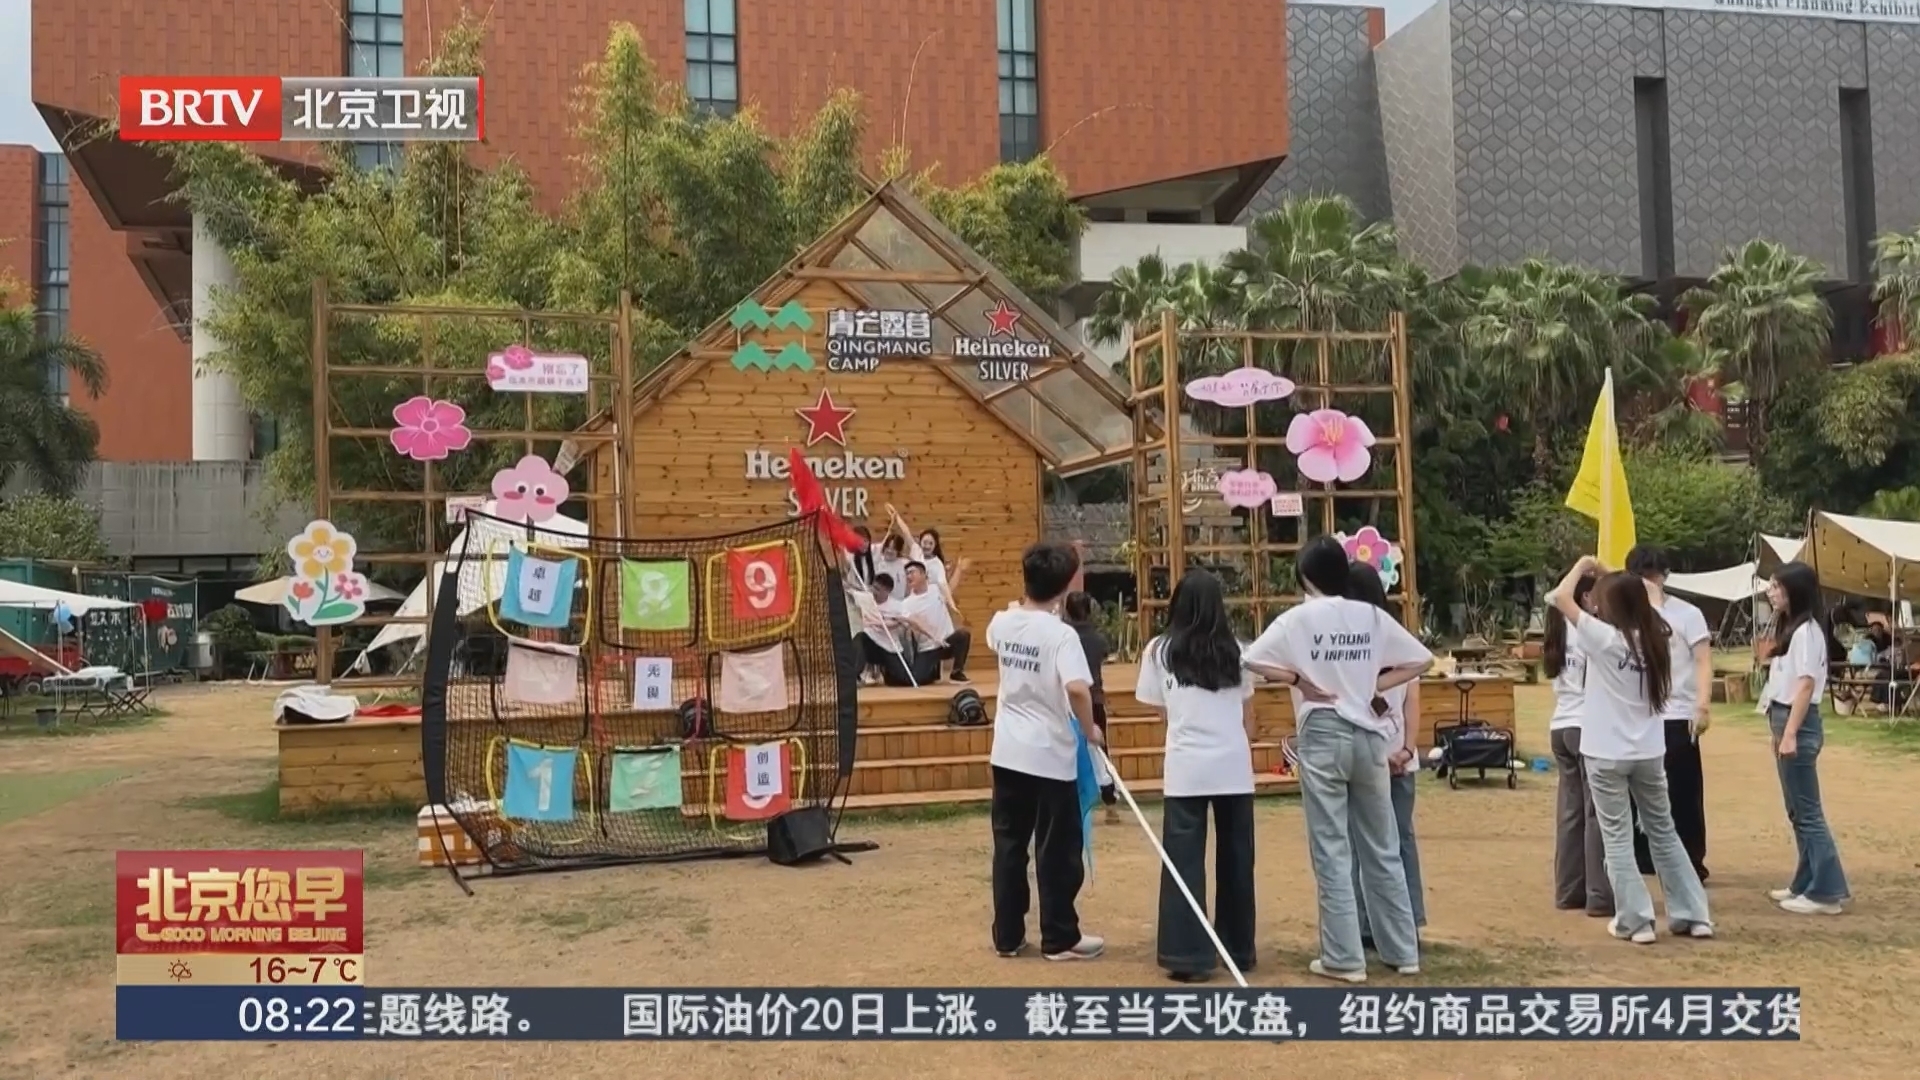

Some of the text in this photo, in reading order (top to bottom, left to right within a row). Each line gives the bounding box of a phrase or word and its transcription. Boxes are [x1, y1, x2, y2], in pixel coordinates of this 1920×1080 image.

[827, 339, 932, 355] QINGMANG
[955, 337, 1051, 358] Heineken
[828, 357, 880, 371] CAMP
[980, 361, 1029, 380] SILVER
[745, 450, 905, 479] Heneken
[787, 486, 869, 517] SVER
[744, 560, 777, 609] 9
[528, 757, 553, 812] 1
